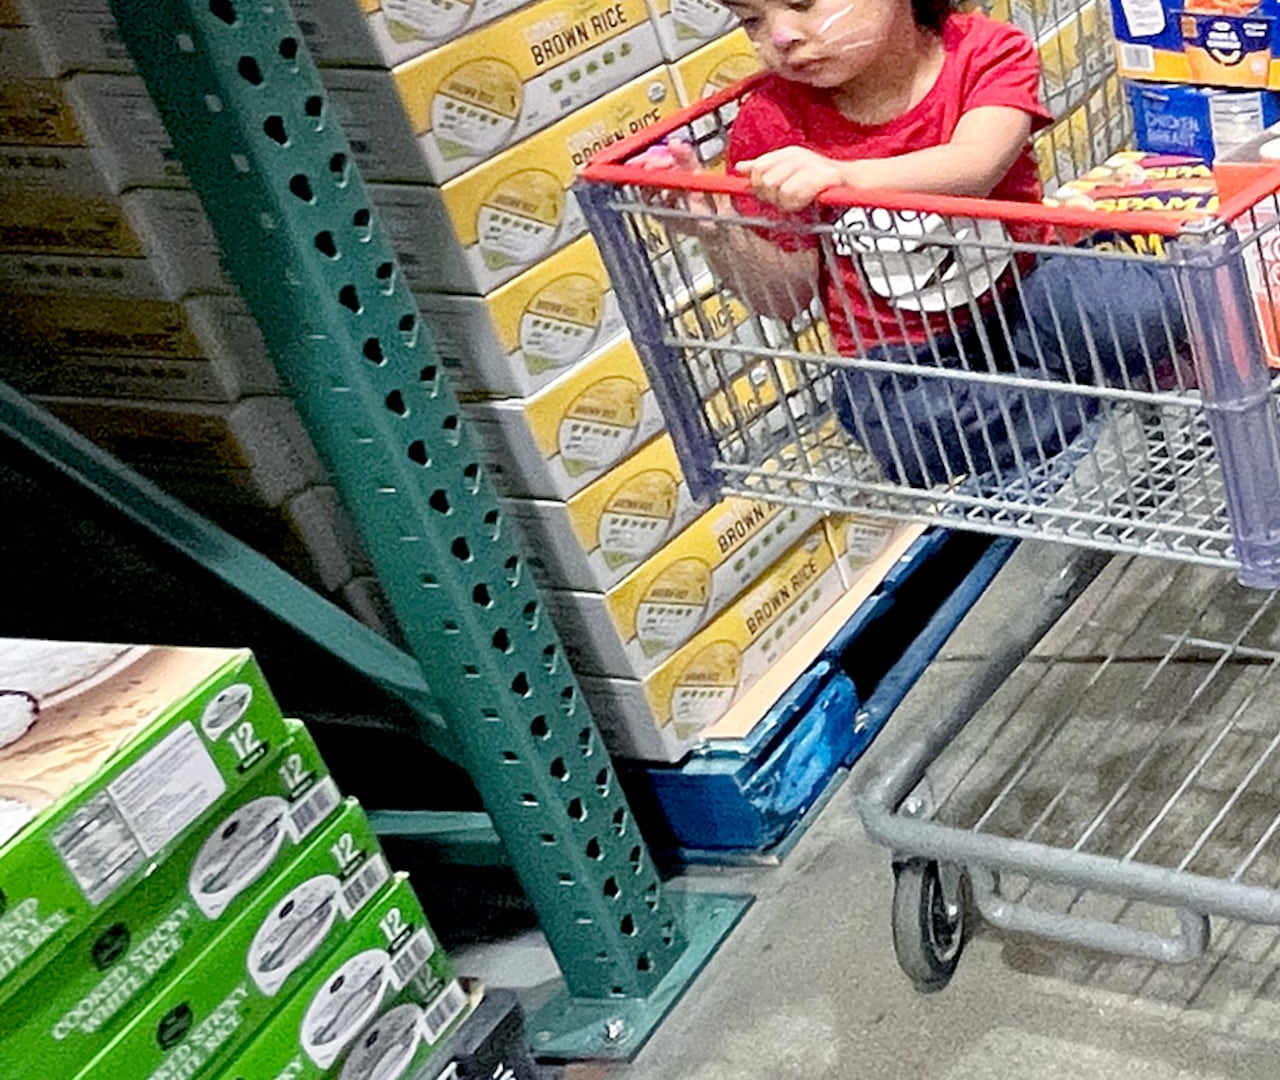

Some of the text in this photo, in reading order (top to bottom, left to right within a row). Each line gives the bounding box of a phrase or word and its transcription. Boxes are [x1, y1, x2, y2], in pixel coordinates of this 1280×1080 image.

[530, 3, 628, 67] BROWN RICE
[717, 506, 767, 555] BROWN
[745, 558, 819, 636] BROWN RICE
[227, 721, 260, 759] 12
[278, 753, 308, 790] 12
[330, 832, 360, 867] 12
[378, 907, 409, 941] 12
[53, 901, 190, 1040] COOKED STICKY
[80, 928, 185, 1033] WHITE RICE
[190, 982, 250, 1048] STICKY
